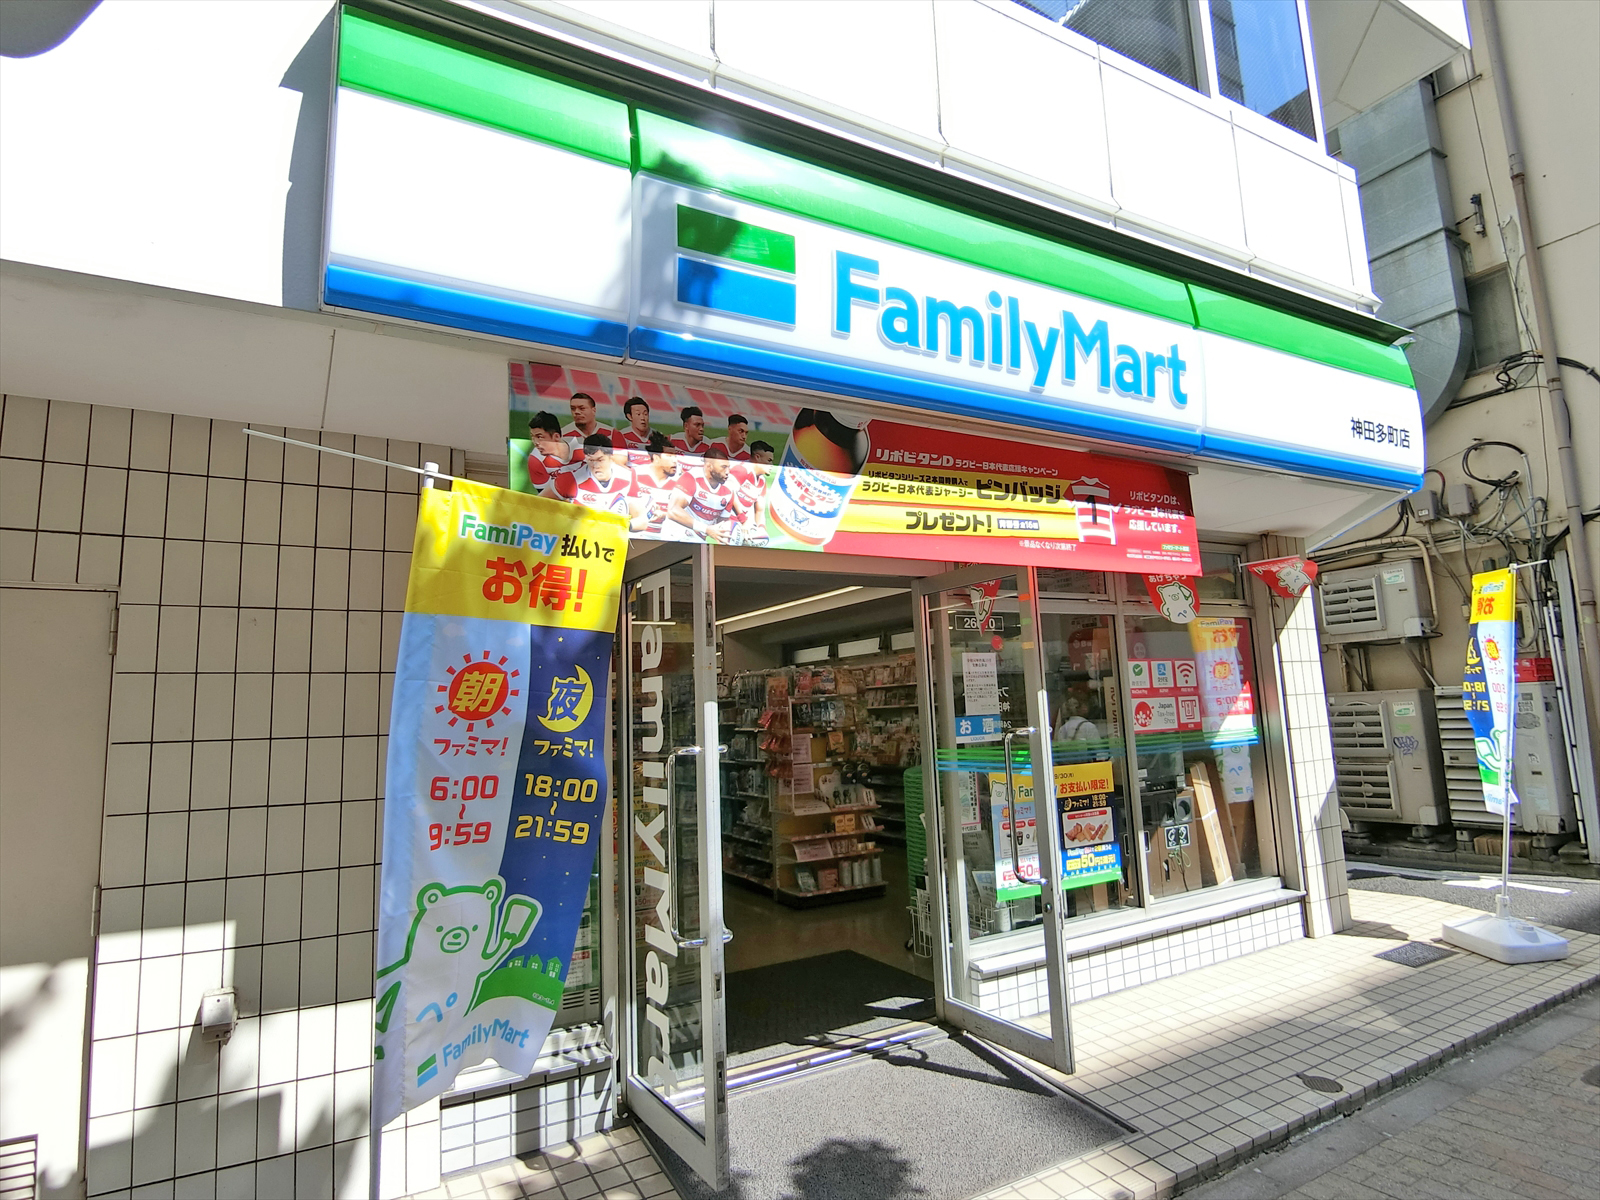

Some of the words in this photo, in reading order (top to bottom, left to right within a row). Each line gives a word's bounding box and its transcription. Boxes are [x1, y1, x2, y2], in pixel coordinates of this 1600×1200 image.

[834, 250, 1190, 408] FamilyMart
[1350, 416, 1411, 449] 神田多町店
[875, 448, 955, 467] リポビタンD
[861, 481, 974, 497] ラグビー日本代表ジャージー
[975, 479, 1062, 504] ピンバッジ
[460, 514, 558, 555] FamiPay
[560, 533, 615, 562] 払いで
[1128, 519, 1182, 534] 応援しています。
[482, 556, 587, 612] お得!
[451, 670, 505, 714] 朝
[544, 675, 587, 723] 夜
[433, 735, 508, 757] ファミマ!
[533, 738, 594, 759] ファミマ!
[429, 775, 499, 802] 6:00
[524, 773, 599, 803] 18:00
[428, 821, 492, 851] 9:59
[514, 815, 590, 845] 21:59
[634, 568, 680, 1098] FamilyMart
[443, 1017, 529, 1068] FamilyMart
